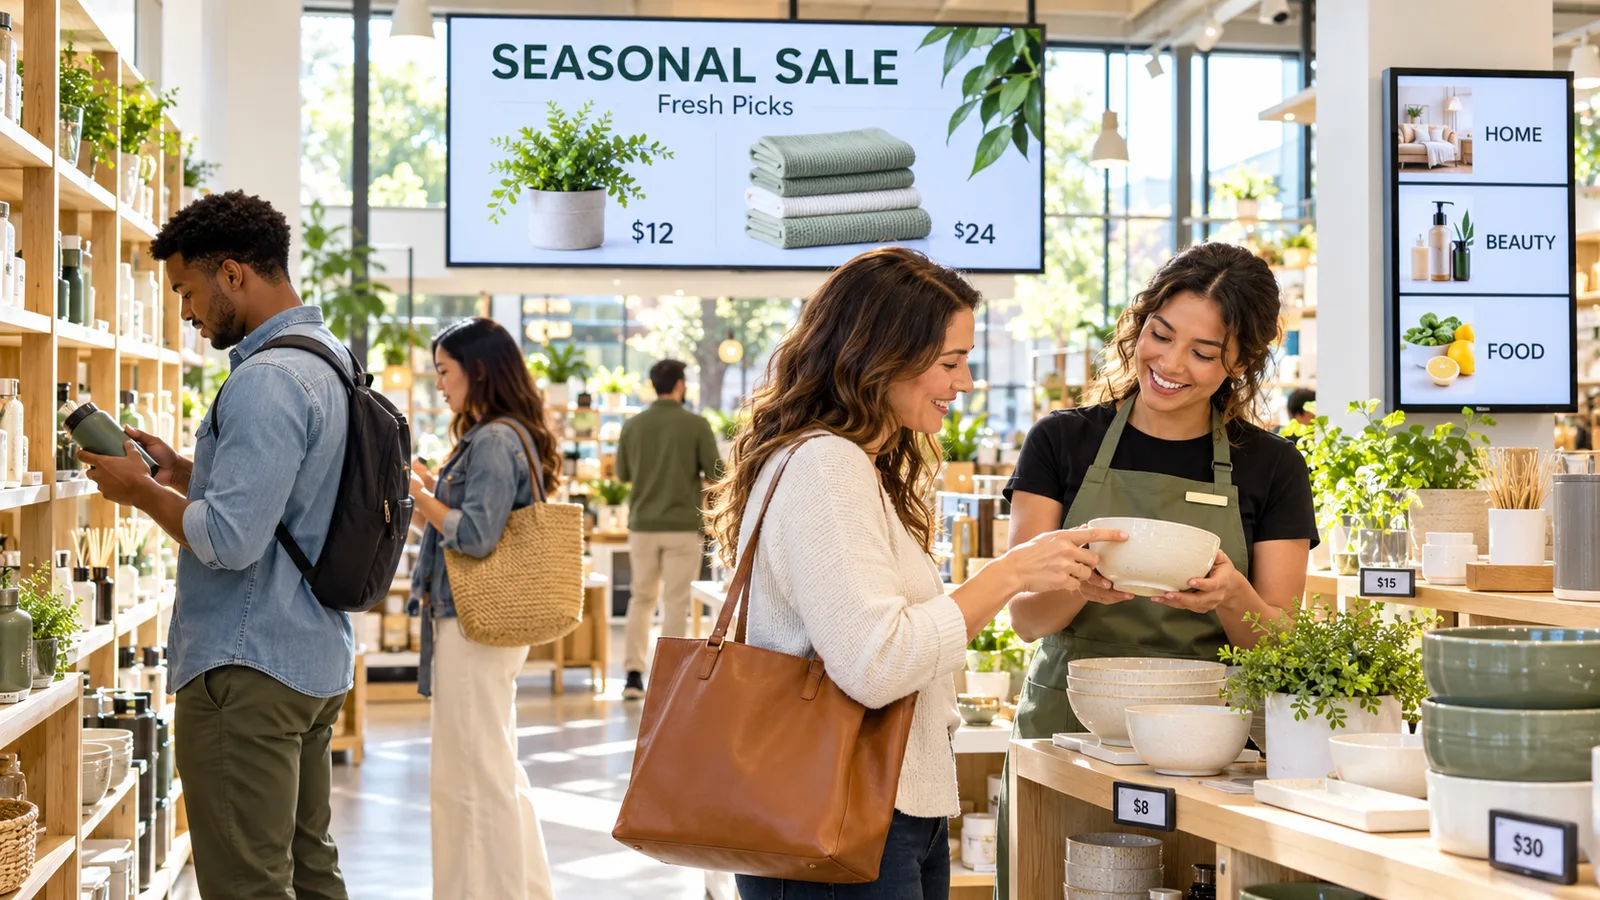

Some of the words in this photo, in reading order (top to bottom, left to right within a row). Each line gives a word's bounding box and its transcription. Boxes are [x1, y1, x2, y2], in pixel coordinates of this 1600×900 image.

[491, 43, 757, 84] SEASONAL
[775, 48, 899, 86] SALE
[658, 94, 723, 115] Fresh
[733, 95, 794, 116] Picks
[1485, 126, 1543, 142] HOME
[632, 219, 674, 245] $12
[954, 221, 996, 245] $24
[1486, 234, 1556, 251] BEAUTY
[1488, 343, 1545, 360] FOOD
[1377, 576, 1397, 589] $15
[1133, 797, 1149, 815] $8
[1513, 832, 1544, 858] $30
